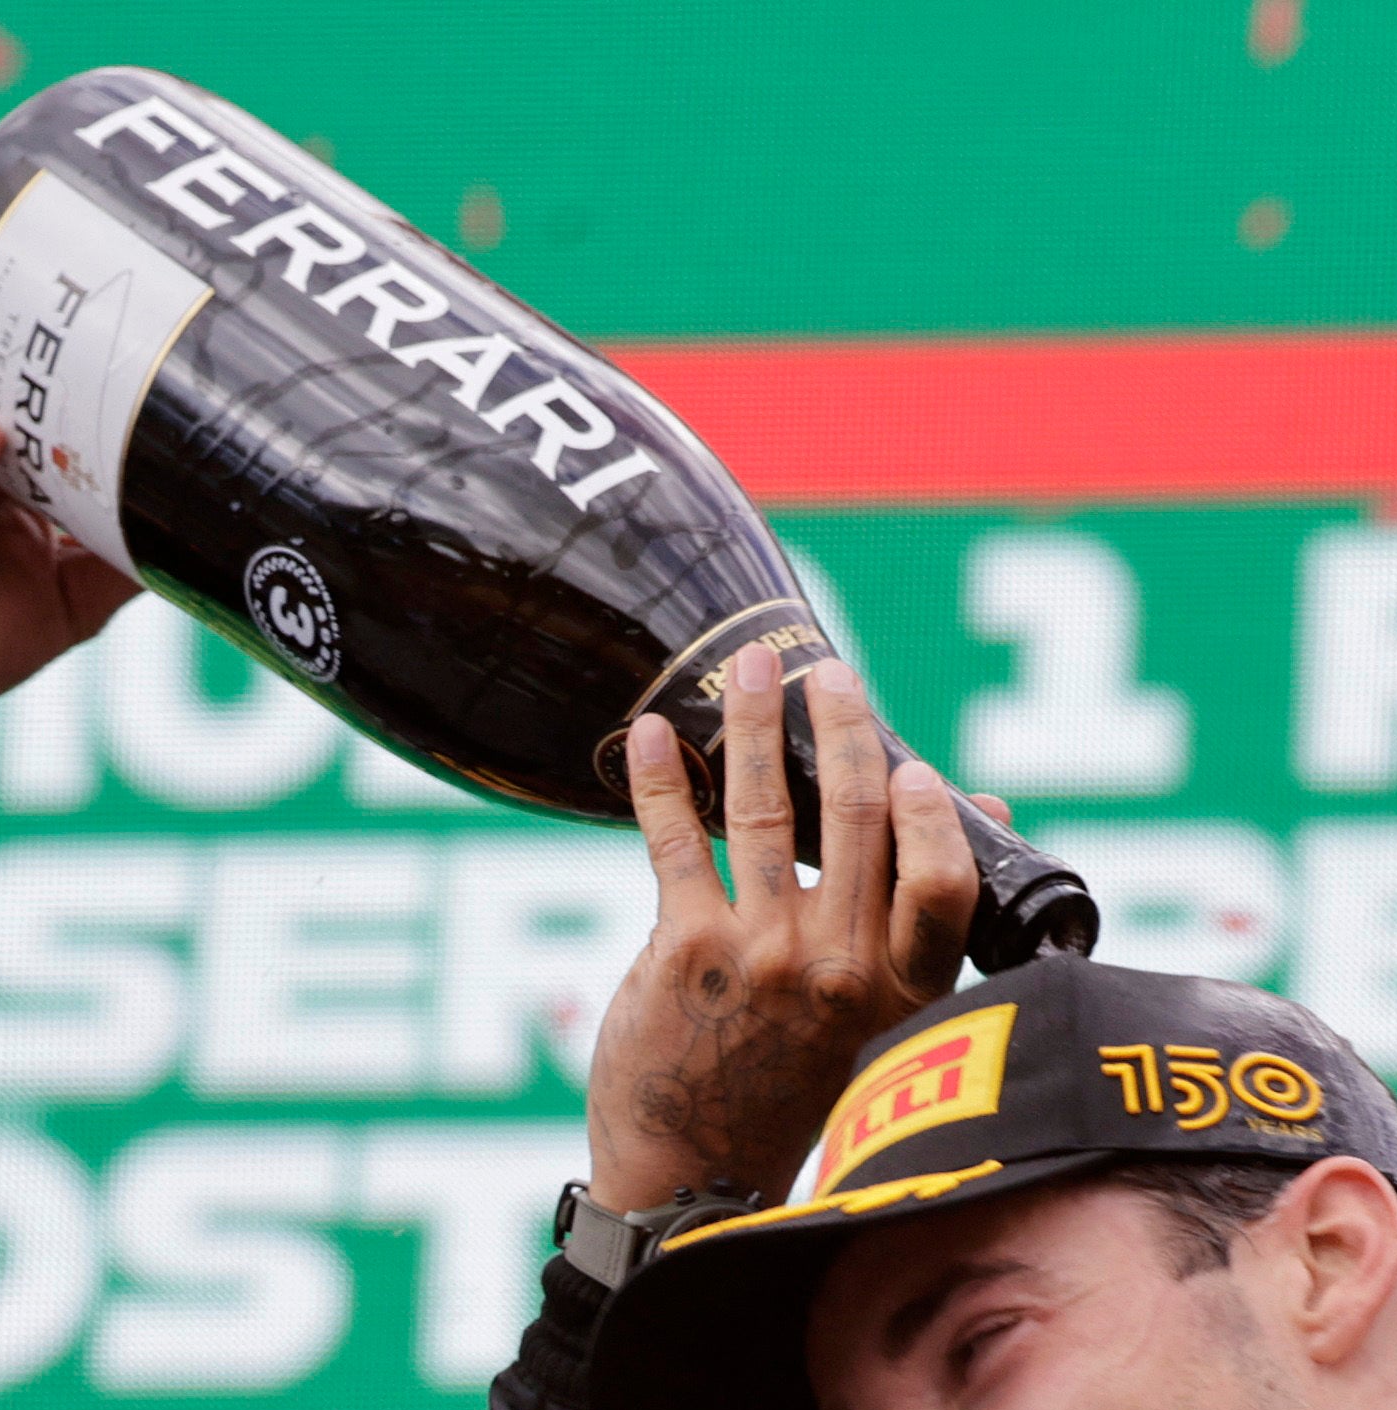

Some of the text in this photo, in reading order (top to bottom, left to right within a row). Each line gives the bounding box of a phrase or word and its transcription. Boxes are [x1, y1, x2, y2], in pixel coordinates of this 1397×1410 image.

[14, 272, 89, 506] FERRA
[74, 95, 661, 512] FERRARI
[954, 526, 1194, 797] 1
[1098, 1044, 1324, 1131] 150
